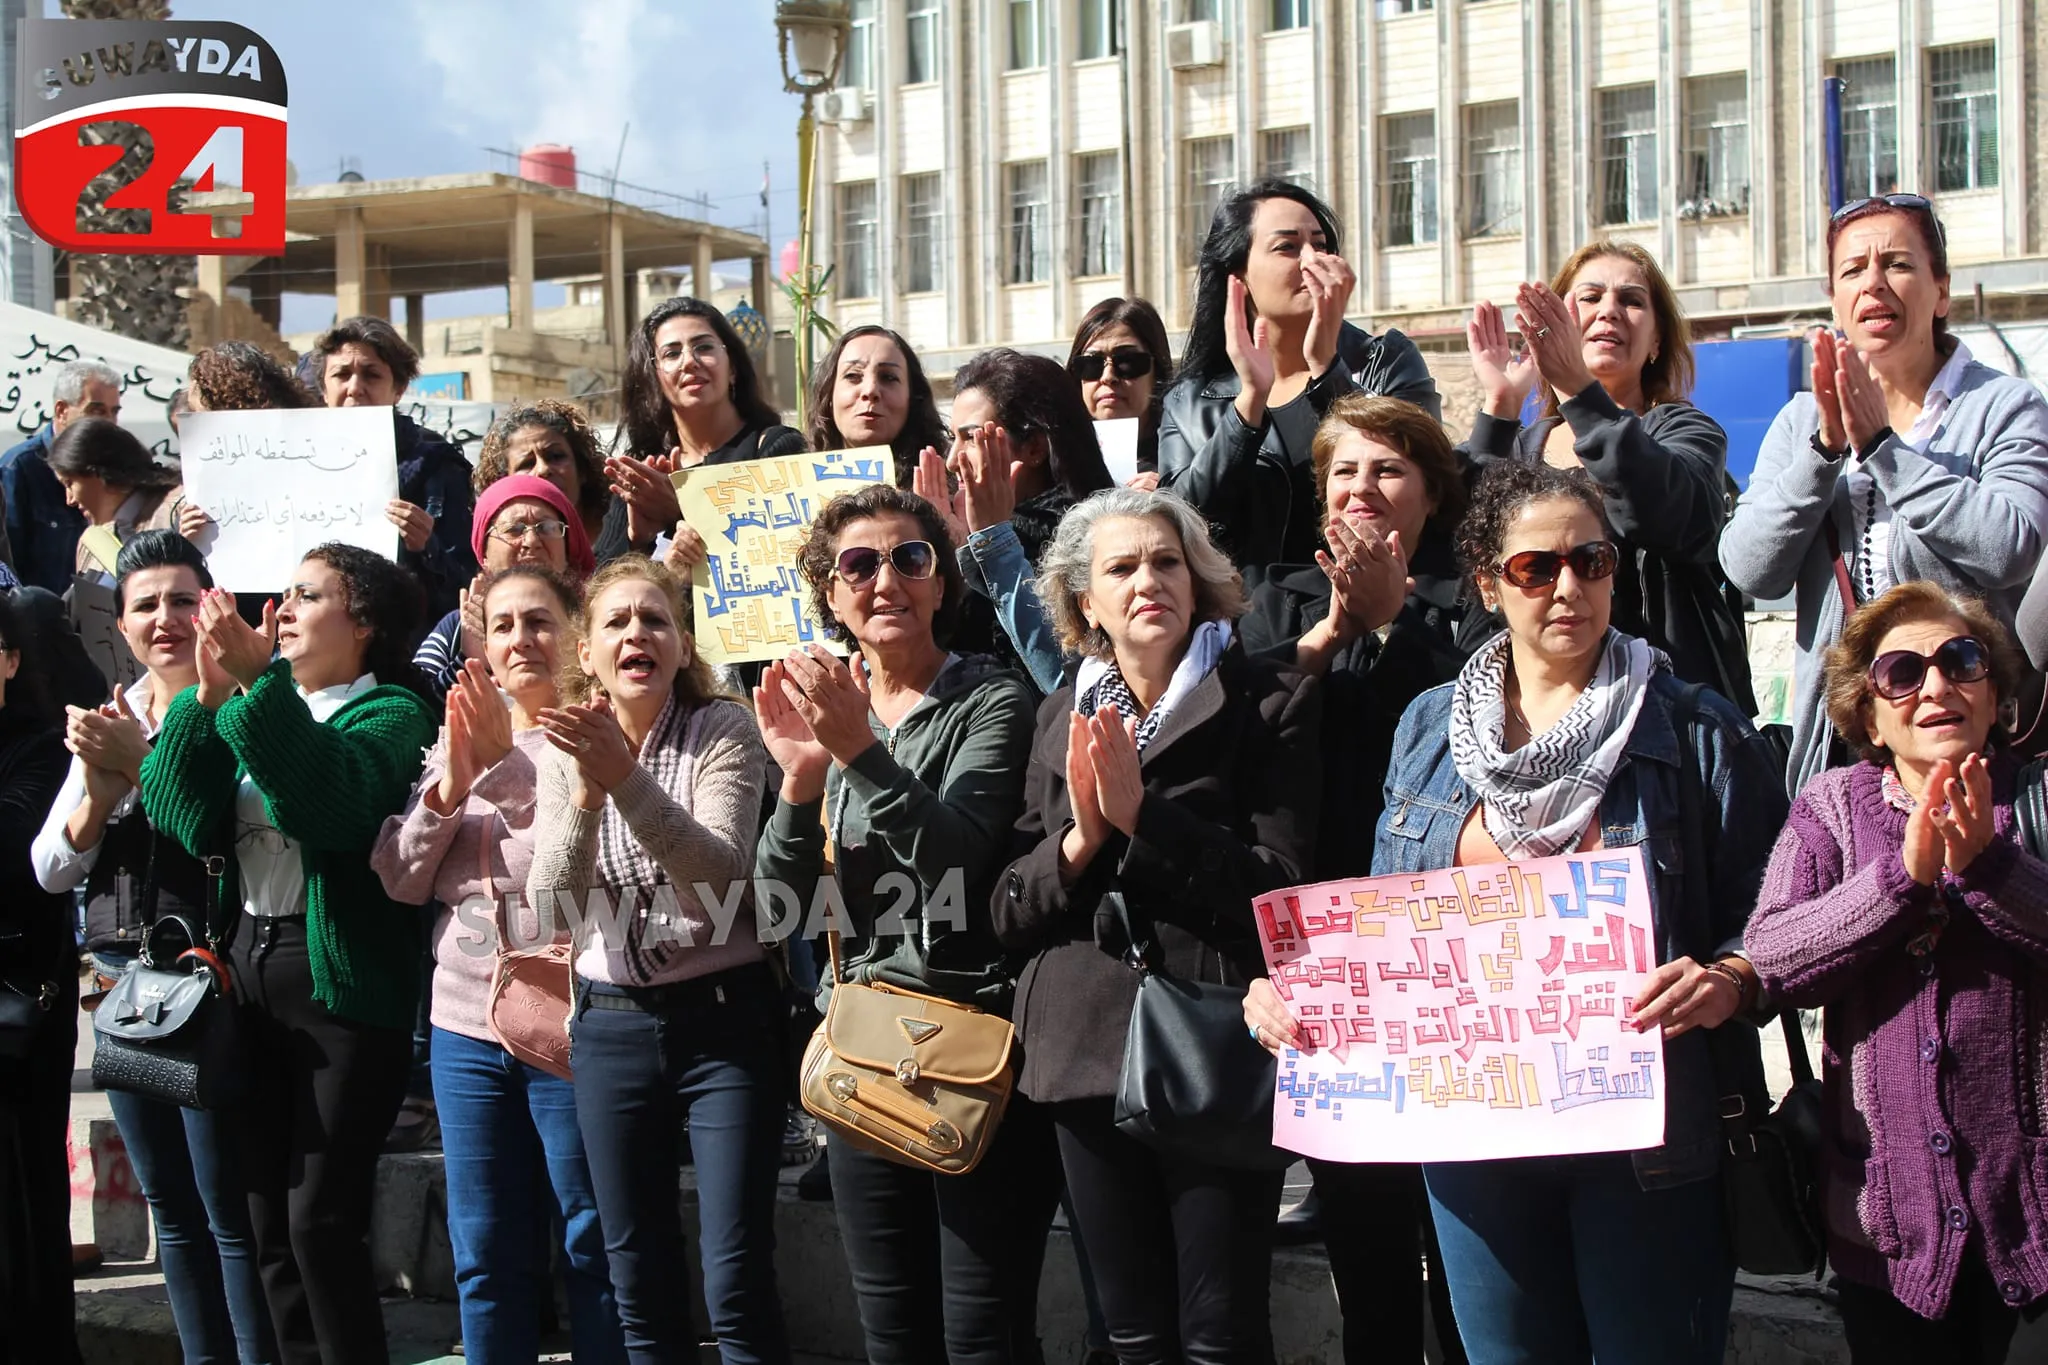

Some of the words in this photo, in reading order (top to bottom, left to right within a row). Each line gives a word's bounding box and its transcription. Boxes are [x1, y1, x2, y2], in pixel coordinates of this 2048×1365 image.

[199, 434, 250, 466] المواقف
[306, 447, 368, 471] من
[273, 494, 295, 533] أي
[703, 461, 803, 515] الماضي
[721, 492, 812, 547] الحاضر
[704, 550, 802, 618] المستقبل
[717, 598, 798, 654] منافق
[1351, 889, 1407, 937] مع
[1407, 865, 1546, 932] التضامن
[1549, 858, 1630, 918] كل
[1257, 895, 1354, 953] ضحايا
[1536, 912, 1648, 977] الغدر
[1479, 922, 1522, 993] في
[1413, 1005, 1519, 1063] الفرات
[1278, 1048, 1406, 1121] الصهيونية
[1551, 1042, 1656, 1114] تسقط
